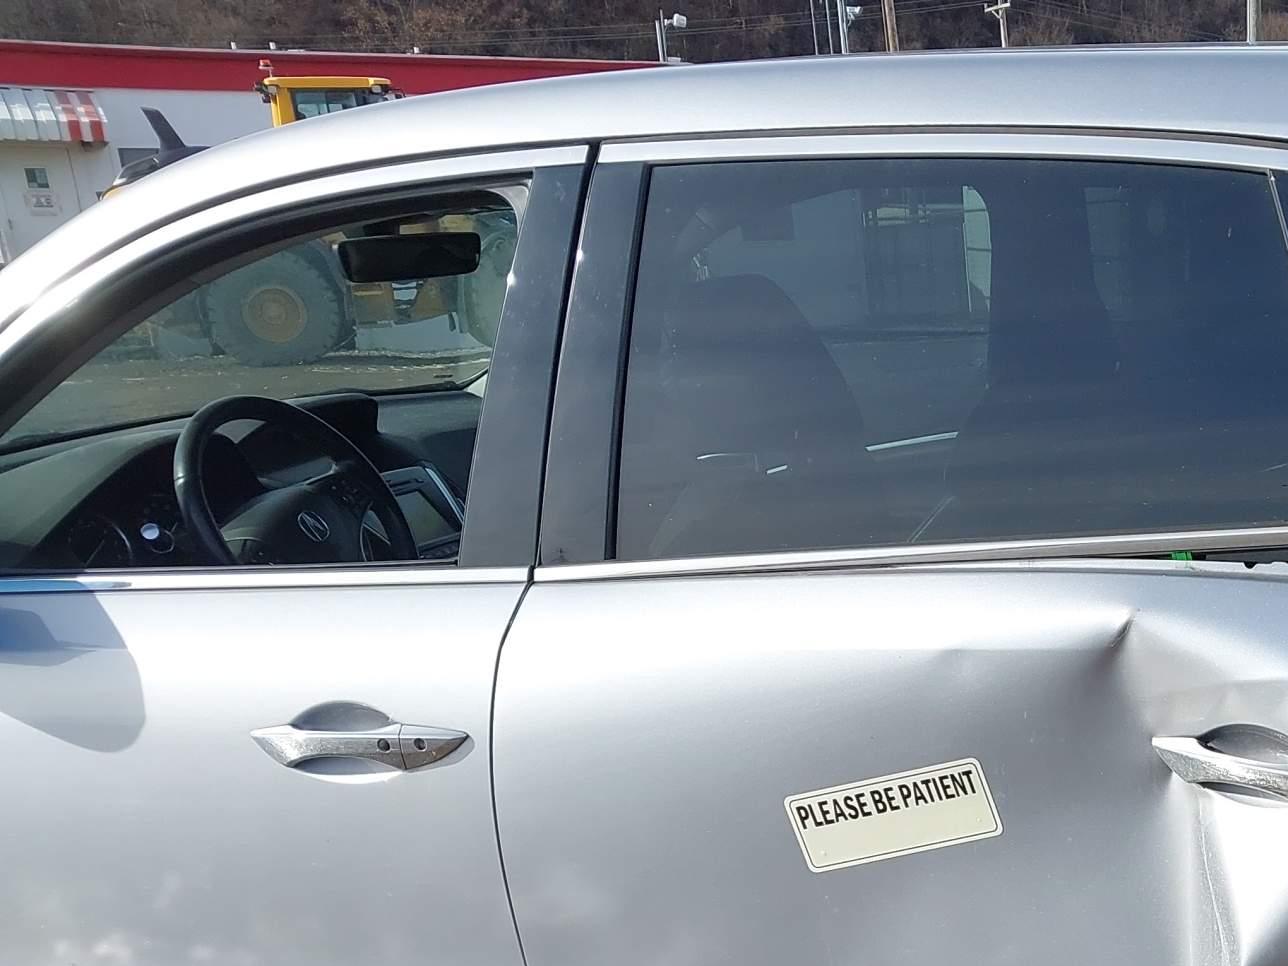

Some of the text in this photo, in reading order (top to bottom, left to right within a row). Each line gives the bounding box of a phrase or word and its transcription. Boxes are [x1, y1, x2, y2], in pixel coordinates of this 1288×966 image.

[796, 770, 976, 829] PLEASE BE PATIENT
